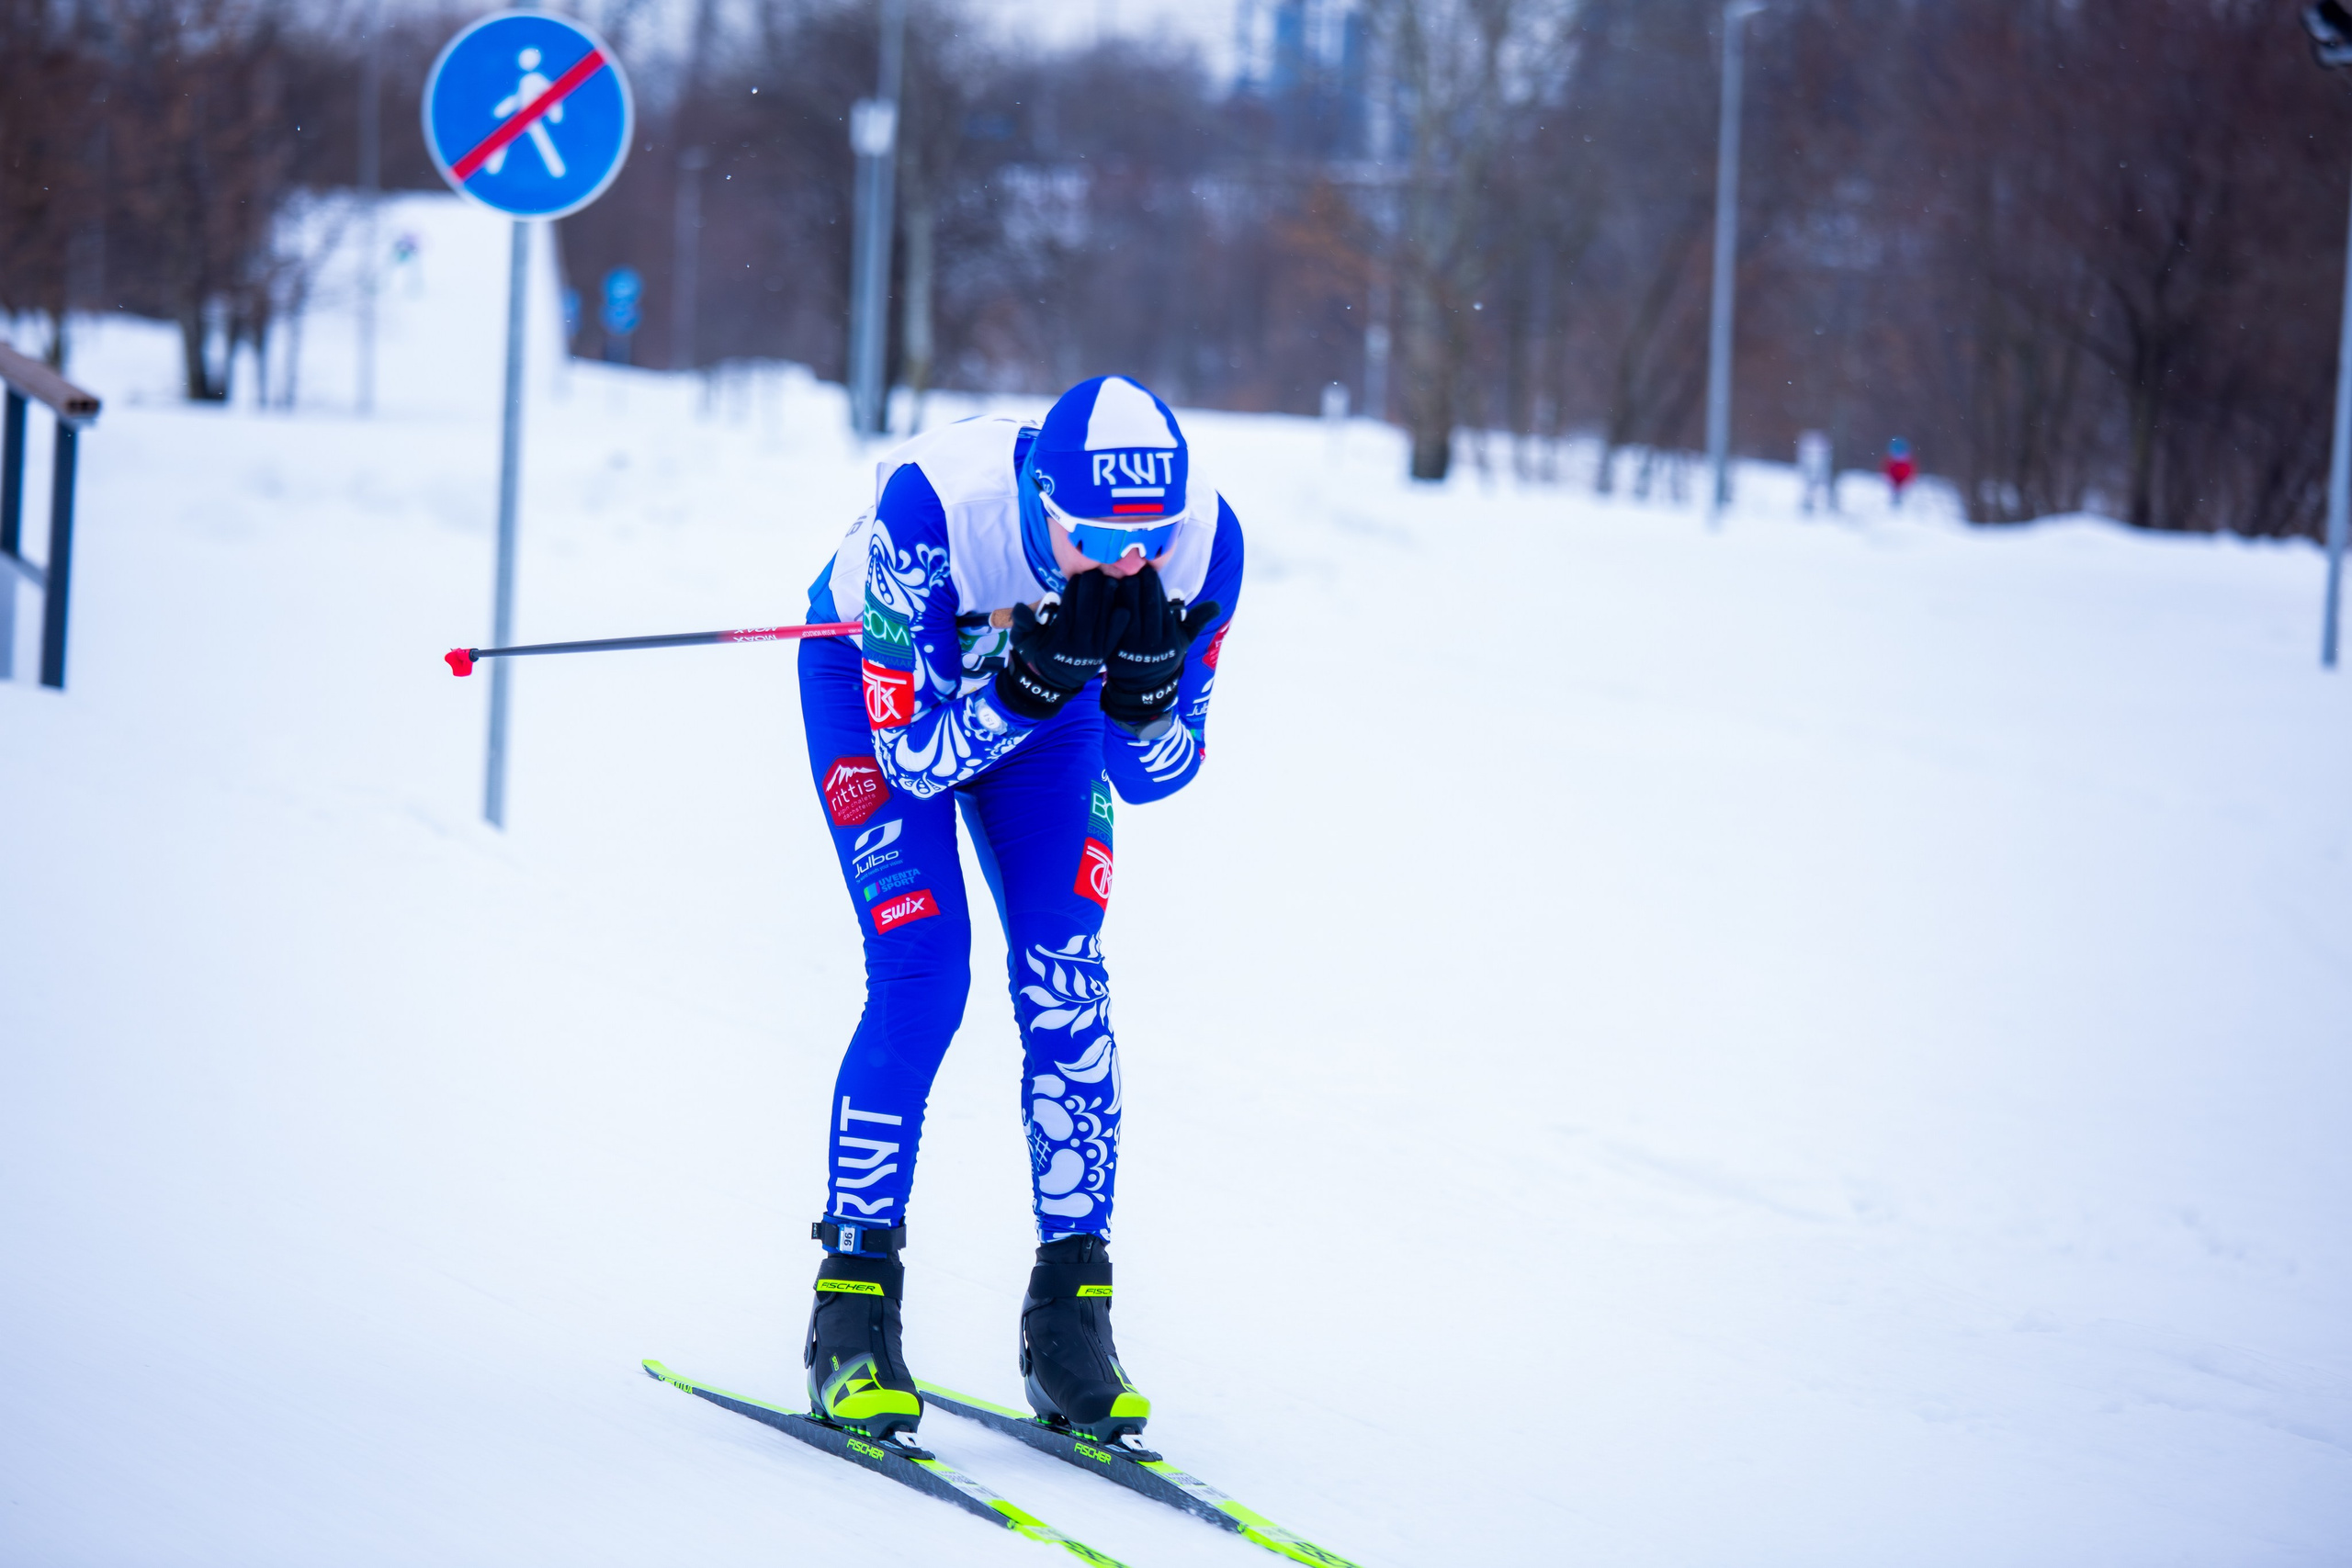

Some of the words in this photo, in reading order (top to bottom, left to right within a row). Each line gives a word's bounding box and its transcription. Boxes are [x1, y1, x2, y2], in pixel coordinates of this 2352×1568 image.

[1092, 452, 1174, 486] RWT
[733, 635, 777, 643] MOAX
[1054, 653, 1103, 666] MADSHUS
[1117, 649, 1176, 663] MADSHUS
[1019, 677, 1060, 702] MOAX
[1141, 679, 1178, 702] MOAX
[831, 779, 876, 811] rittis
[851, 793, 876, 808] chalets
[842, 801, 874, 820] dachstein
[878, 868, 921, 886] UVENTA
[881, 876, 915, 892] SPORT
[843, 1232, 854, 1247] 96
[820, 1281, 876, 1292] FISCHER
[846, 1438, 885, 1461] FISCHER
[1073, 1442, 1112, 1465] FISCHER
